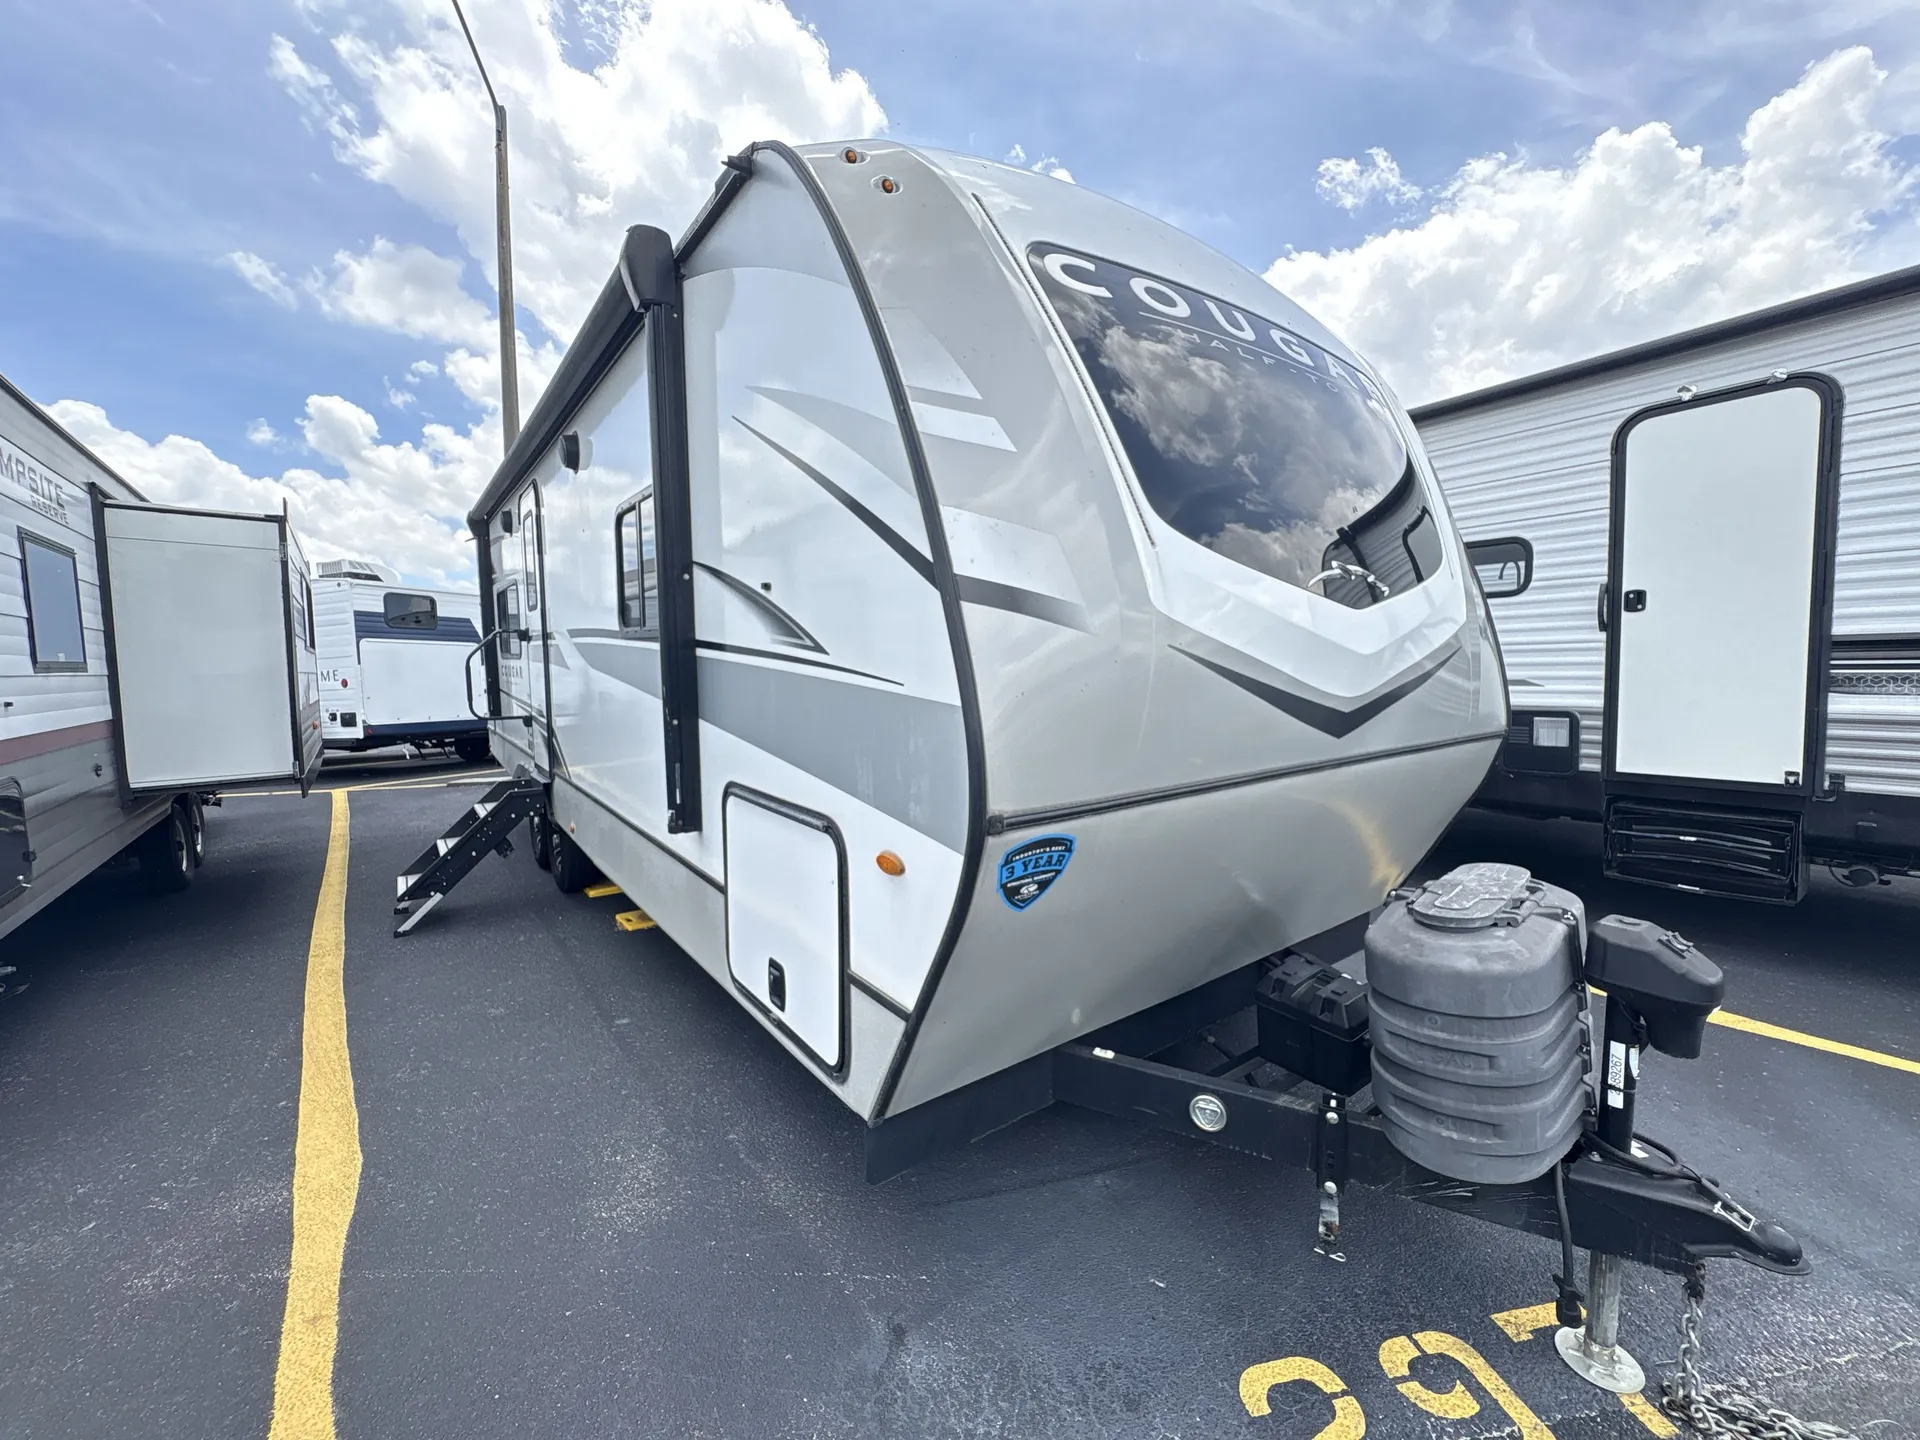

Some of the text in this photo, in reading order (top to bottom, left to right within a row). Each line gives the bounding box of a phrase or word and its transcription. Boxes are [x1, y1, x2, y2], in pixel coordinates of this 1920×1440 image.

[1043, 252, 1386, 408] COUGAR
[1176, 329, 1339, 393] HALF-TO
[30, 494, 69, 525] RESERVE
[320, 669, 339, 682] ME
[501, 665, 523, 679] COUGAR
[1005, 865, 1015, 880] 3
[1022, 854, 1066, 872] YEAR
